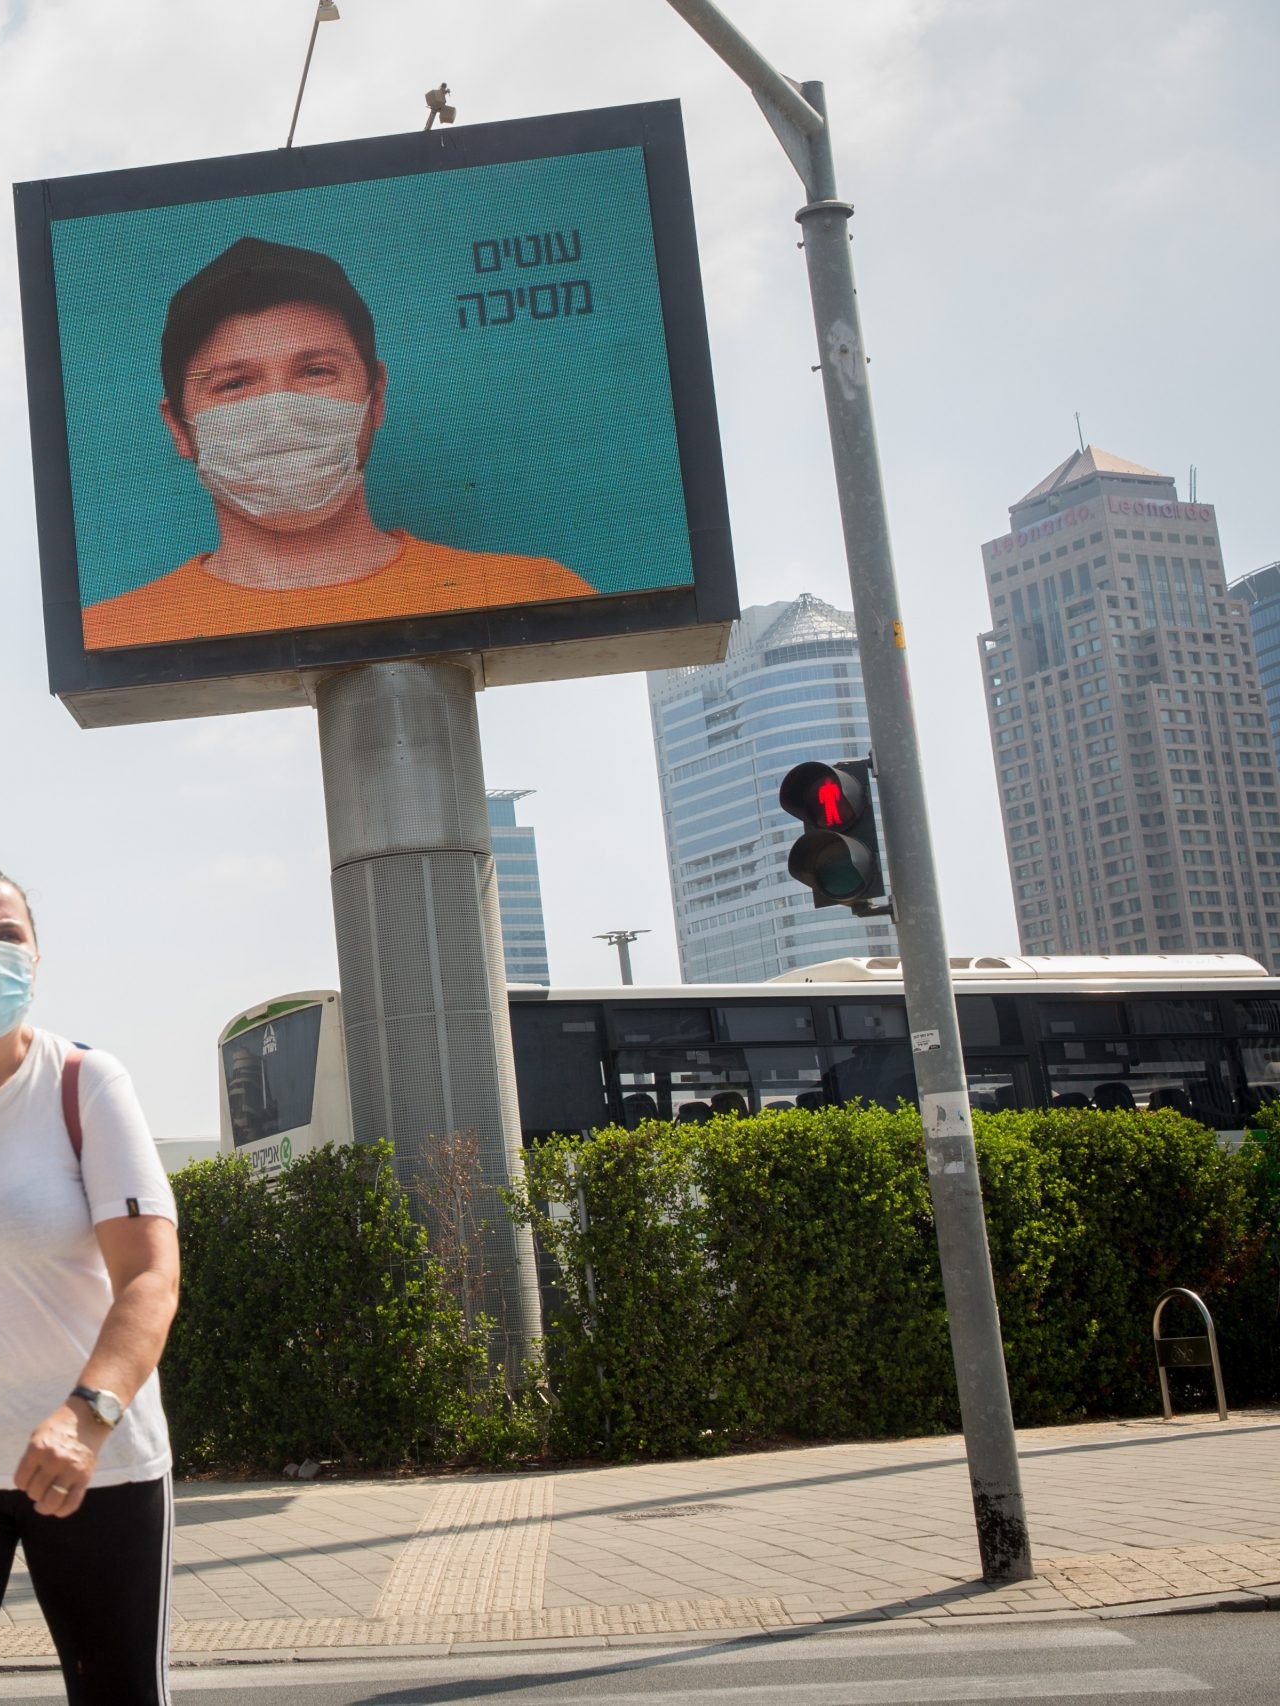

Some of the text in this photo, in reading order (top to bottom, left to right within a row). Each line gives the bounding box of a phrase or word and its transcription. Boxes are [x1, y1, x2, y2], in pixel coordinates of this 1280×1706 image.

[473, 229, 581, 273] עוטים
[456, 279, 593, 329] מסיכה
[1107, 495, 1213, 522] Leonardo
[252, 1144, 280, 1169] אפיקים
